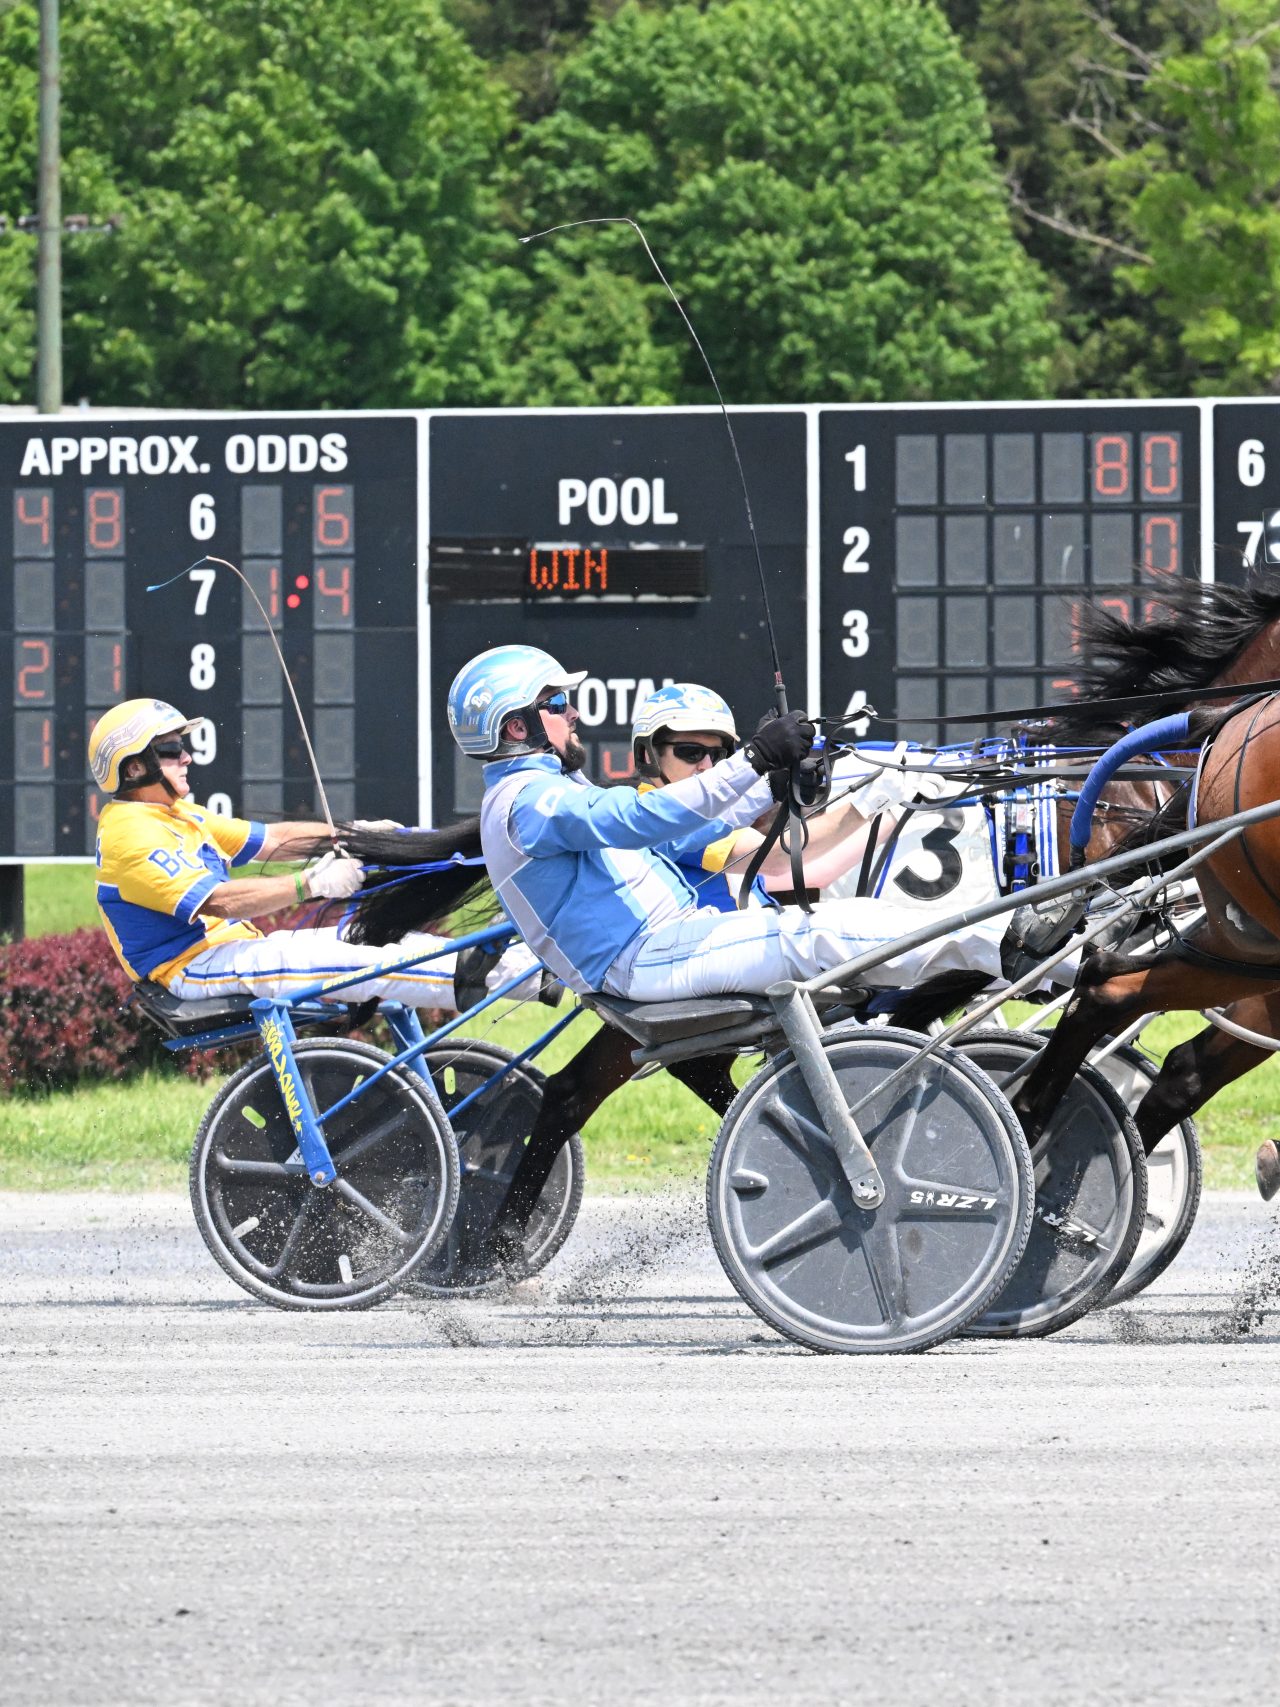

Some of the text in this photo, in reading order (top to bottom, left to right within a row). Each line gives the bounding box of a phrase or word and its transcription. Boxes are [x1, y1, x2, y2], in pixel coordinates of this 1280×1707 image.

[20, 433, 348, 476] APPROX. ODDS
[844, 444, 867, 492] 1
[1095, 436, 1178, 495] 80
[1237, 439, 1266, 487] 6
[189, 493, 217, 541] 6
[317, 488, 350, 547] 6
[558, 478, 678, 525] POOL
[842, 526, 871, 573] 2
[1236, 521, 1264, 568] 7
[188, 569, 216, 616] 7
[530, 548, 608, 590] WIN
[842, 609, 869, 658] 3
[189, 643, 217, 691] 8
[841, 690, 871, 737] 4
[190, 718, 217, 766] 9
[893, 806, 964, 901] 3
[910, 1190, 998, 1210] LZR 5
